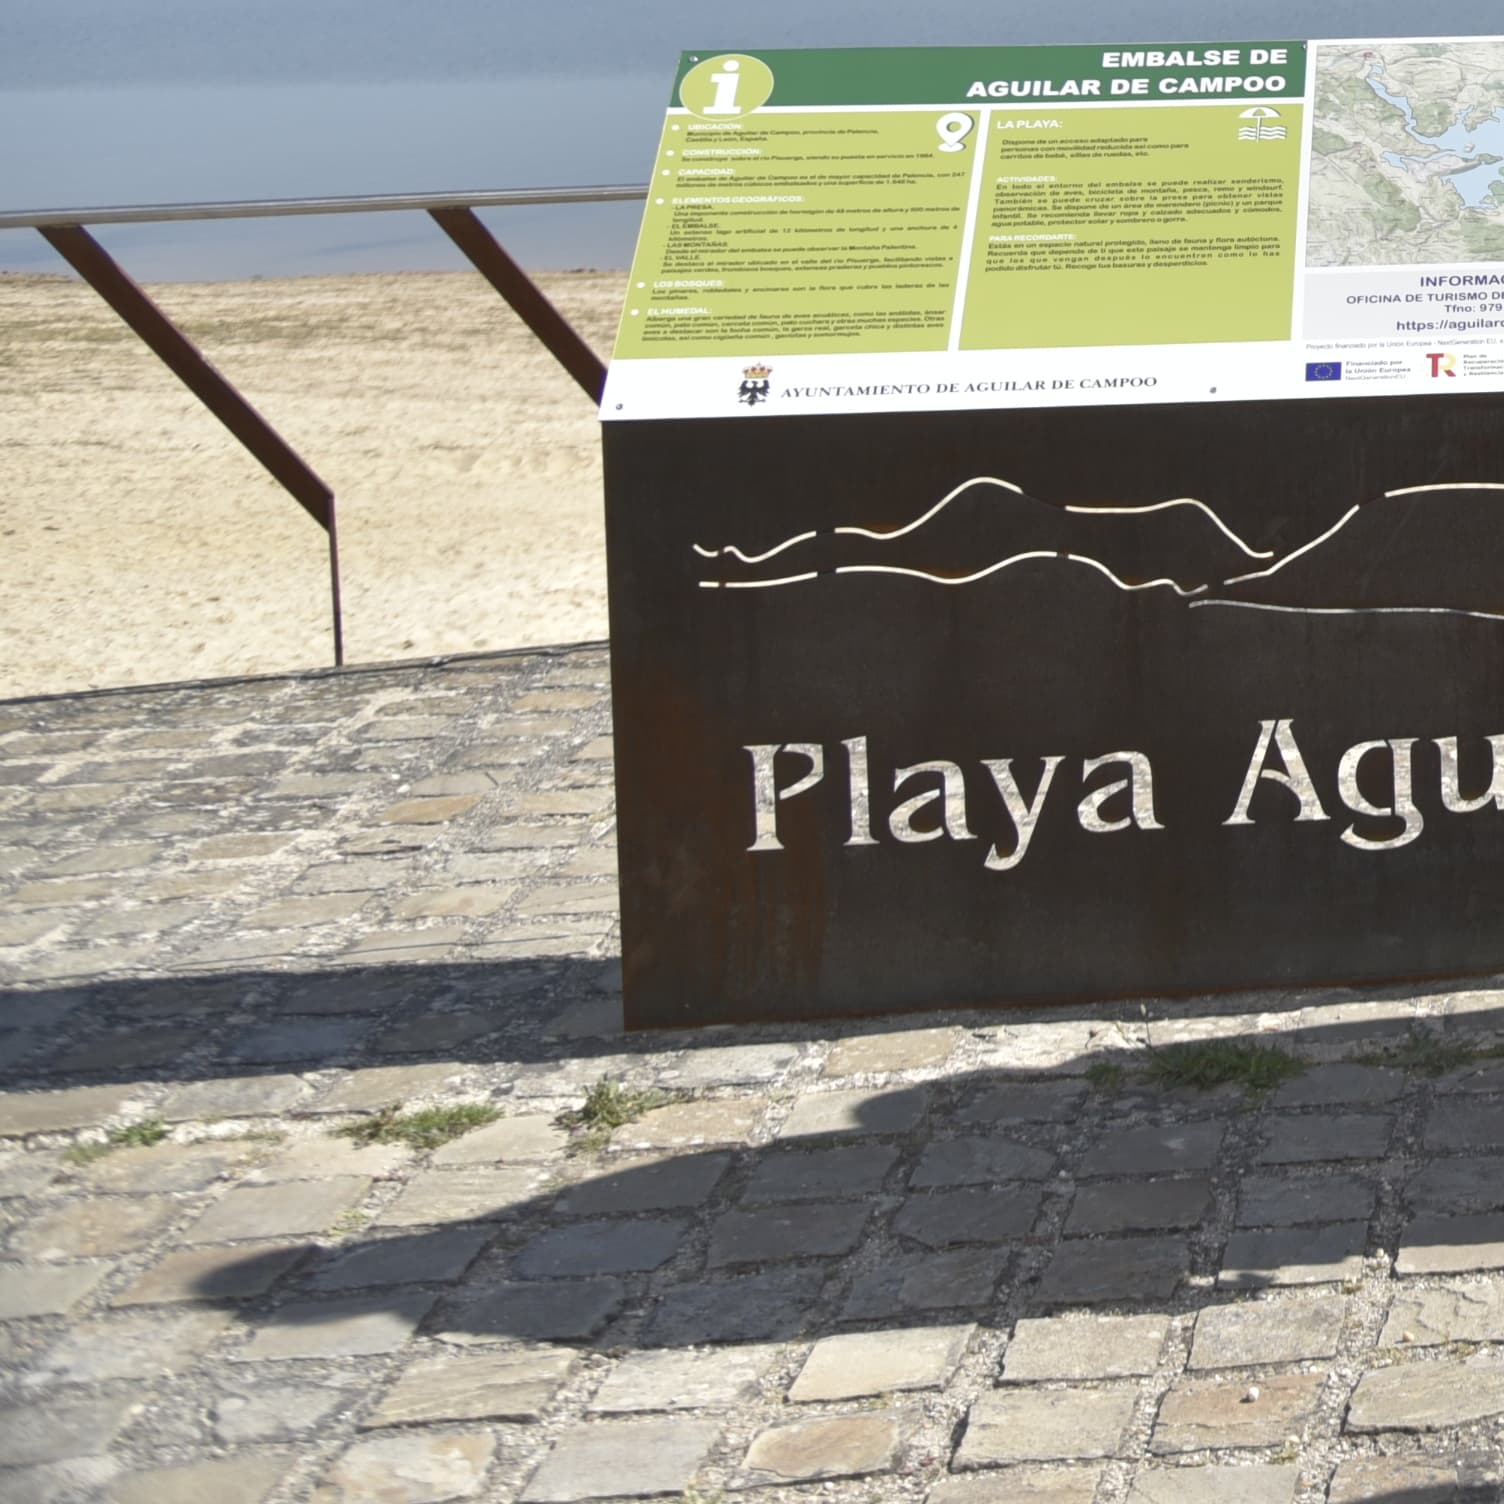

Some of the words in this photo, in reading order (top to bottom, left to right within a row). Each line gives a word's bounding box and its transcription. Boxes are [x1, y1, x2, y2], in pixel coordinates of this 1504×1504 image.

[1102, 49, 1241, 68] EMBALSE
[1249, 49, 1288, 65] DE
[966, 79, 1101, 97] AGUILAR
[1110, 78, 1150, 95] DE
[1158, 75, 1286, 94] CAMPOO
[1346, 294, 1402, 305] OFICINA
[1405, 293, 1424, 303] DE
[1427, 291, 1489, 303] TURISMO
[1444, 303, 1476, 313] Tfno:
[1479, 302, 1503, 312] 979
[780, 382, 931, 399] AYUNTAMIENTO
[935, 381, 960, 395] DE
[964, 379, 1047, 394] AGUILAR
[1051, 378, 1075, 390] DE
[1079, 376, 1159, 389] CAMPOO
[742, 735, 1166, 872] Playa
